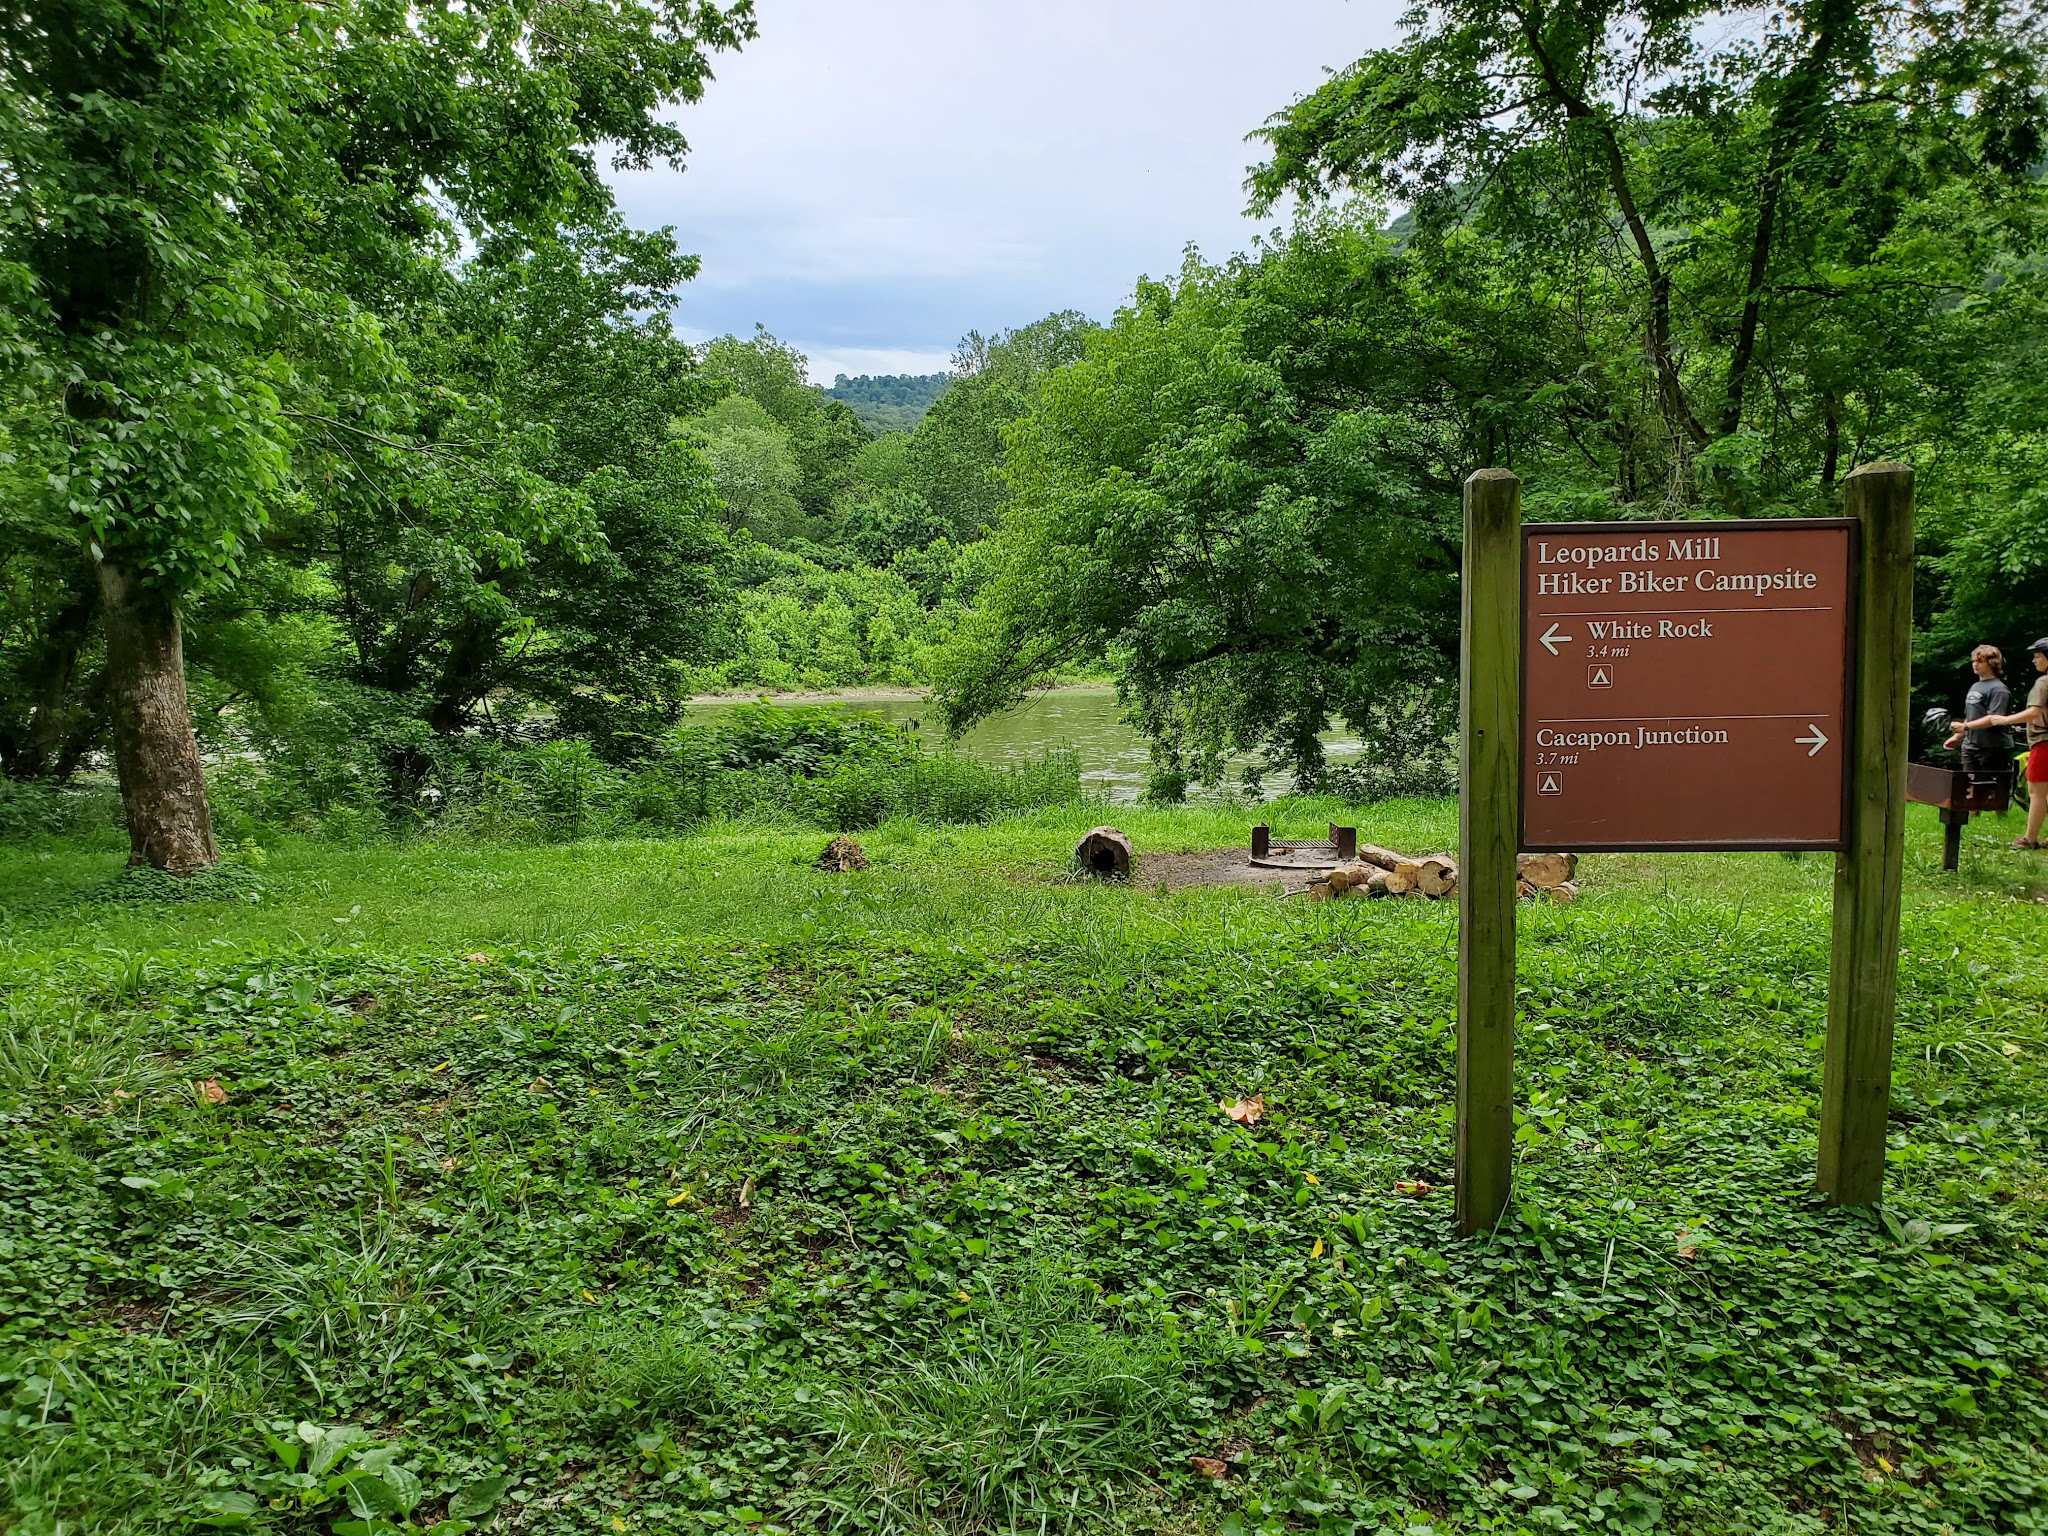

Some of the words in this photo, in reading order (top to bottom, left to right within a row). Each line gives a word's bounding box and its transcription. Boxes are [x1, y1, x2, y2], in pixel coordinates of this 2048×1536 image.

[1538, 539, 1660, 570] Leopards
[1666, 537, 1721, 561] Mill
[1537, 572, 1613, 595] Hiker
[1618, 571, 1688, 593] Biker
[1695, 567, 1817, 597] Campsite
[1586, 620, 1652, 640] White
[1657, 618, 1713, 638] Rock
[1586, 645, 1608, 658] 3.4
[1610, 644, 1630, 658] mi
[1536, 728, 1631, 751] Cacapon
[1634, 726, 1729, 749] Junction
[1535, 752, 1558, 765] 3.7
[1559, 751, 1579, 765] mi
